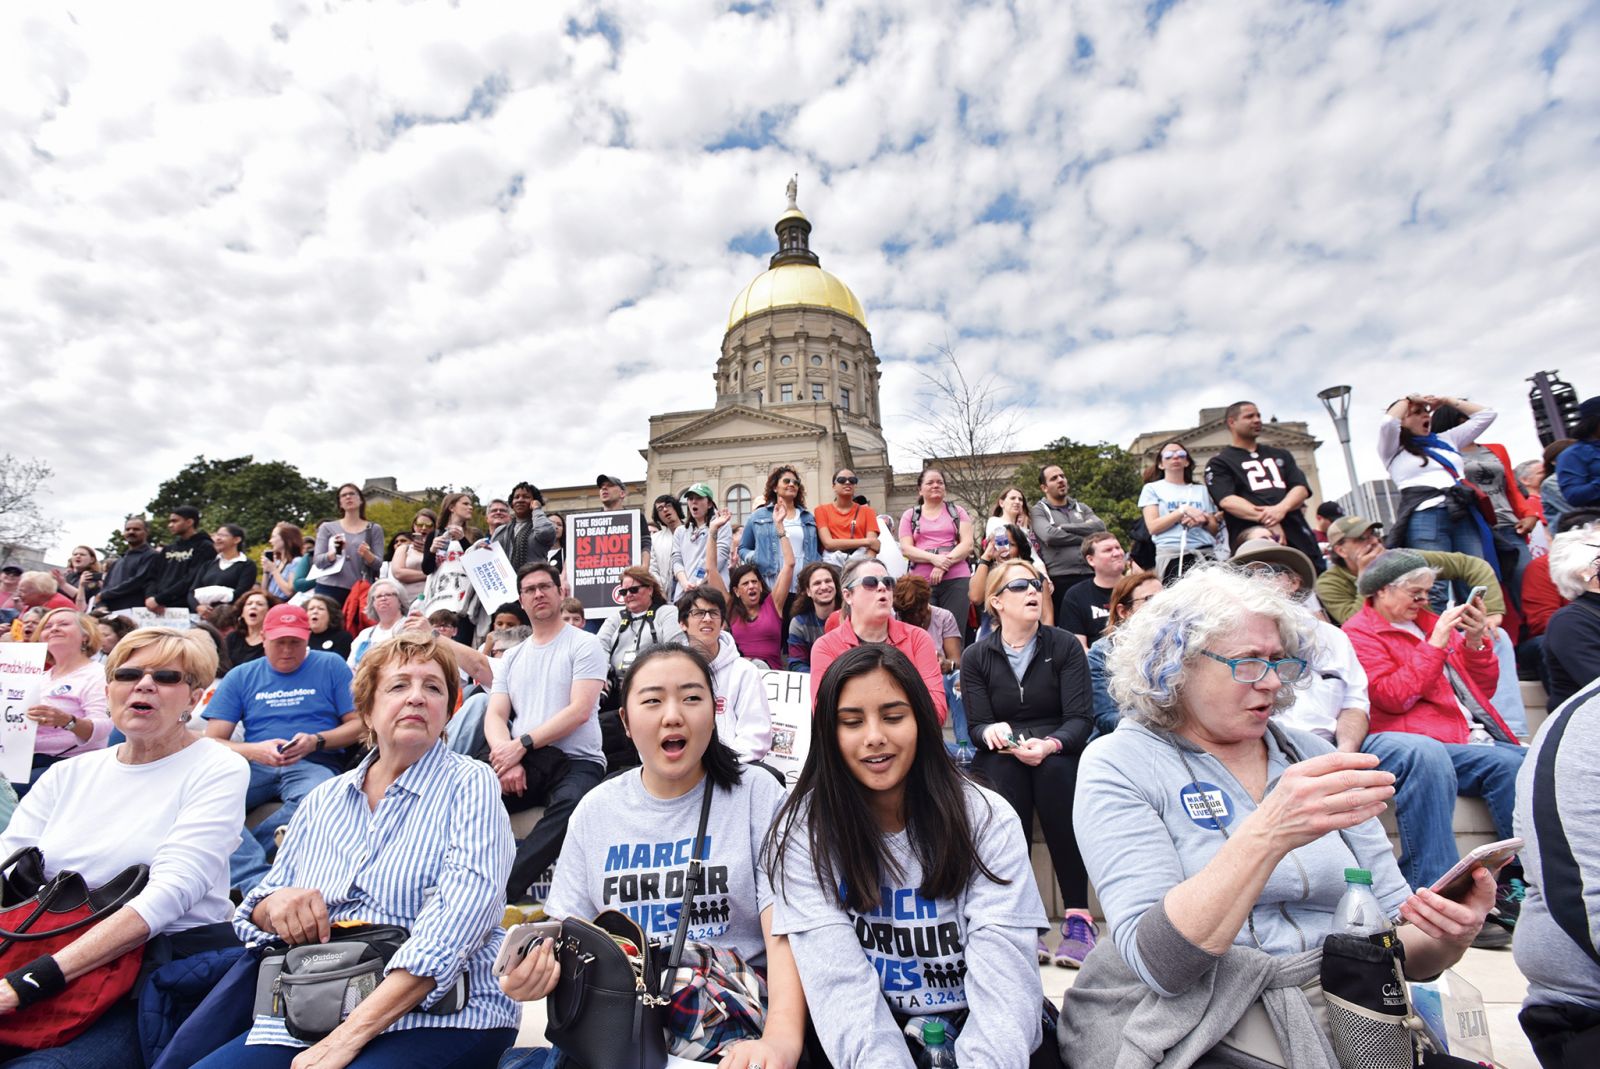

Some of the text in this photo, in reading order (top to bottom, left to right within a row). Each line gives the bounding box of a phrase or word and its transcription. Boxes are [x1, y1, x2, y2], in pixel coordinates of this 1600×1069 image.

[1241, 457, 1287, 491] 21
[575, 525, 629, 537] TO BEAR ARMS
[576, 517, 613, 528] THE RIGHT
[576, 533, 631, 555] IS NOT
[575, 553, 630, 569] GREATER
[476, 566, 492, 590] ACTION
[481, 563, 499, 591] DEMAND
[487, 561, 508, 594] STUDENTS
[575, 568, 596, 577] THAN
[594, 567, 606, 576] MY
[575, 575, 621, 586] RIGHT TO LIFE.
[255, 688, 317, 701] #NotOneMore
[4, 705, 25, 723] Guns
[1206, 800, 1222, 808] UR
[1192, 809, 1212, 817] LIVE
[602, 872, 660, 905] FOR
[854, 916, 963, 958] OR OUR
[312, 953, 343, 962] Outdoor
[1456, 1010, 1489, 1039] FIJI
